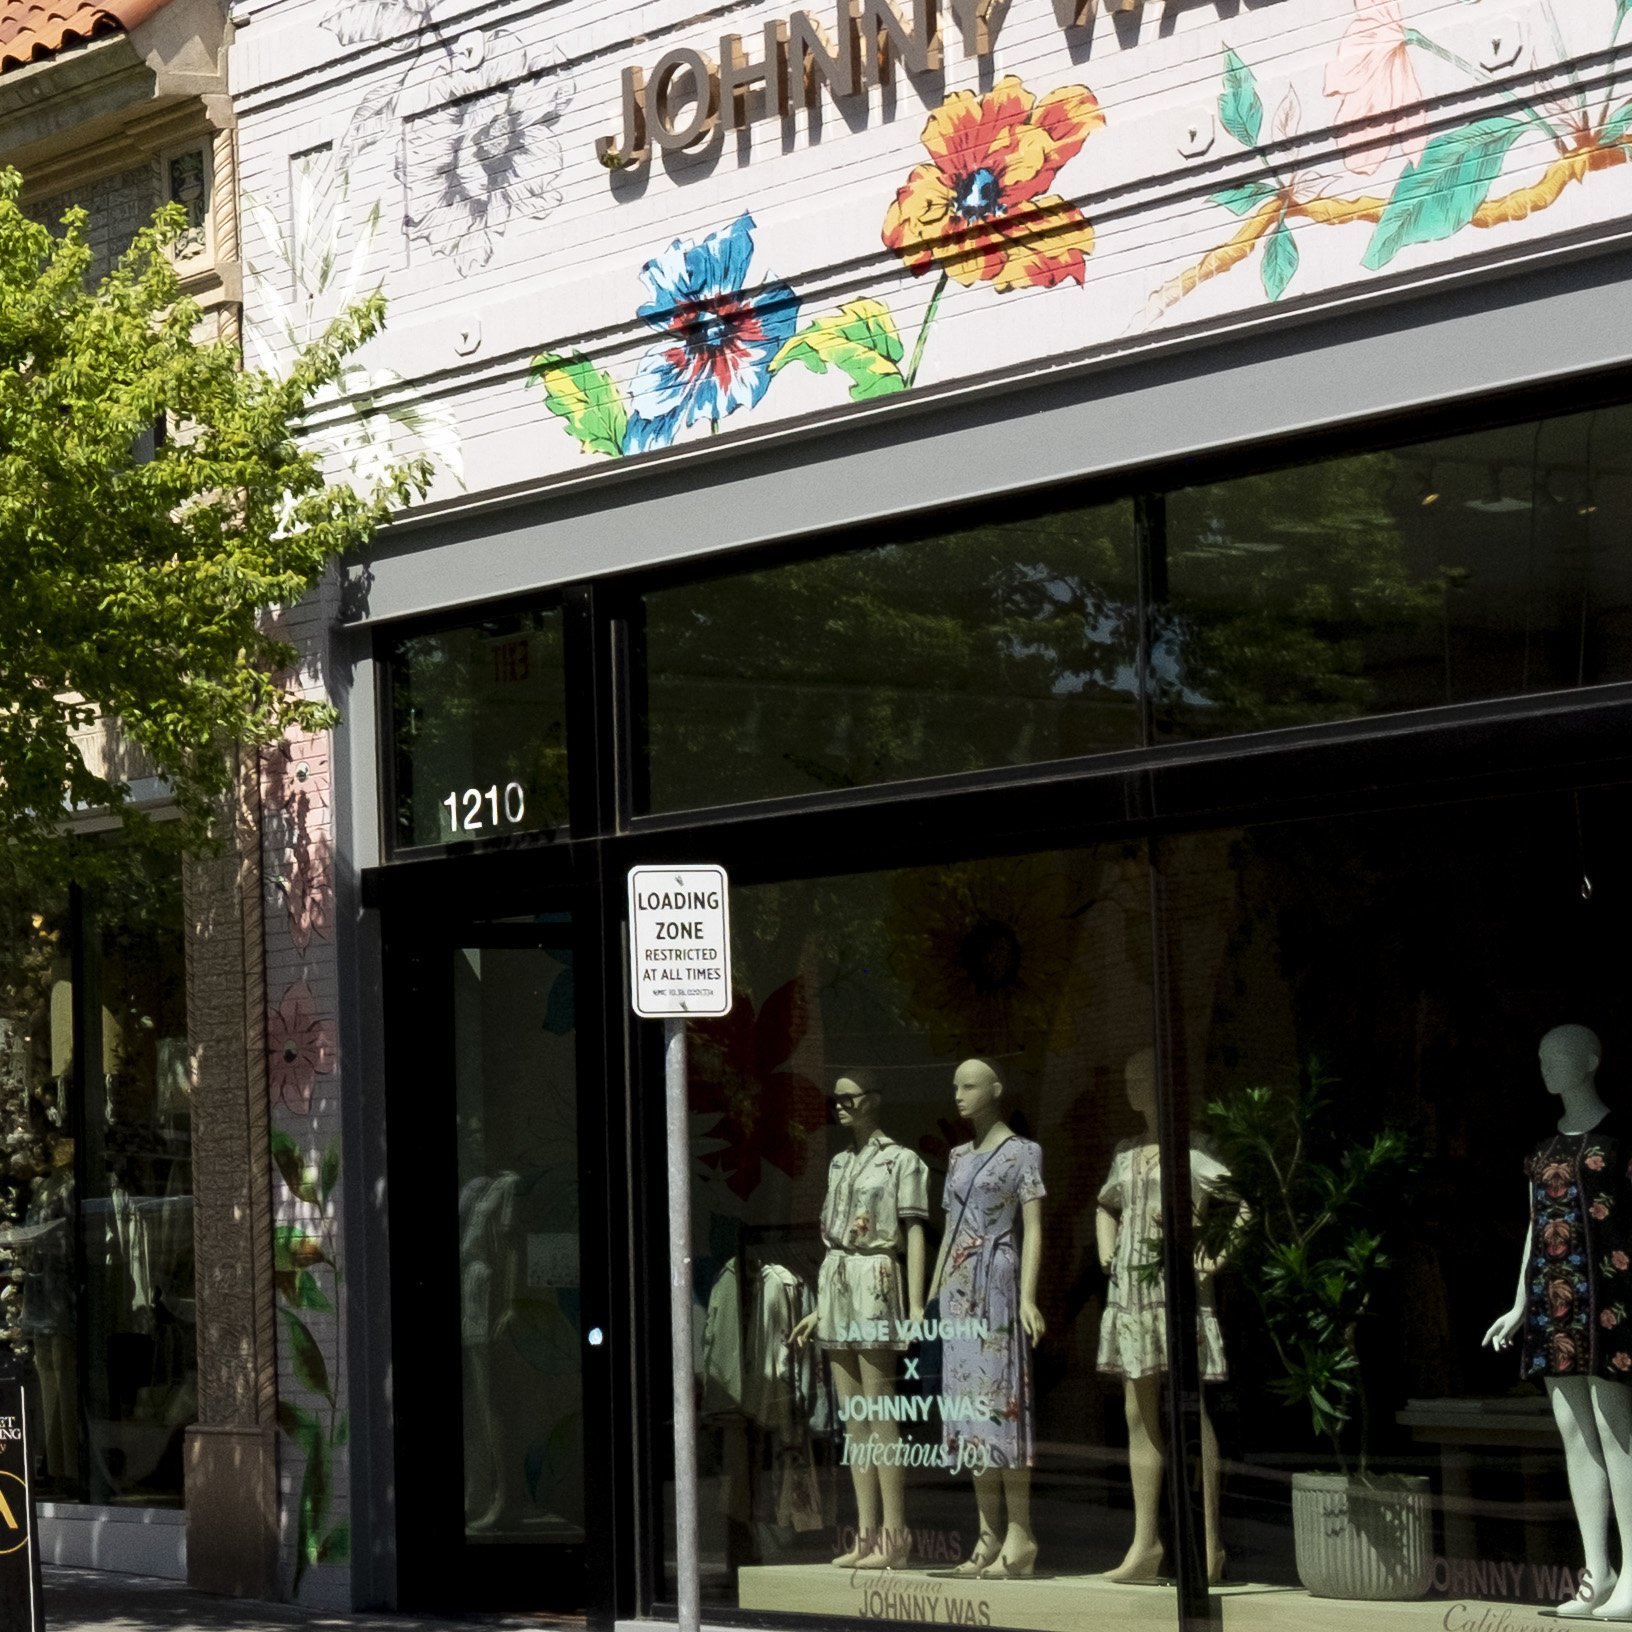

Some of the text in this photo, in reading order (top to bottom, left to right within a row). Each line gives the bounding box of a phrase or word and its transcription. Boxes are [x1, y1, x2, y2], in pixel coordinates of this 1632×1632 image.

[442, 781, 525, 832] 1210
[637, 891, 720, 911] LOADING
[655, 921, 705, 940] ZONE
[644, 948, 718, 961] RESTRICTED
[642, 968, 722, 981] AT ALL TIMES
[836, 1319, 988, 1342] SAGE VAUGHN
[903, 1357, 920, 1380] X
[837, 1394, 991, 1422] JOHNNY WAS
[838, 1431, 992, 1477] Infectious Joy
